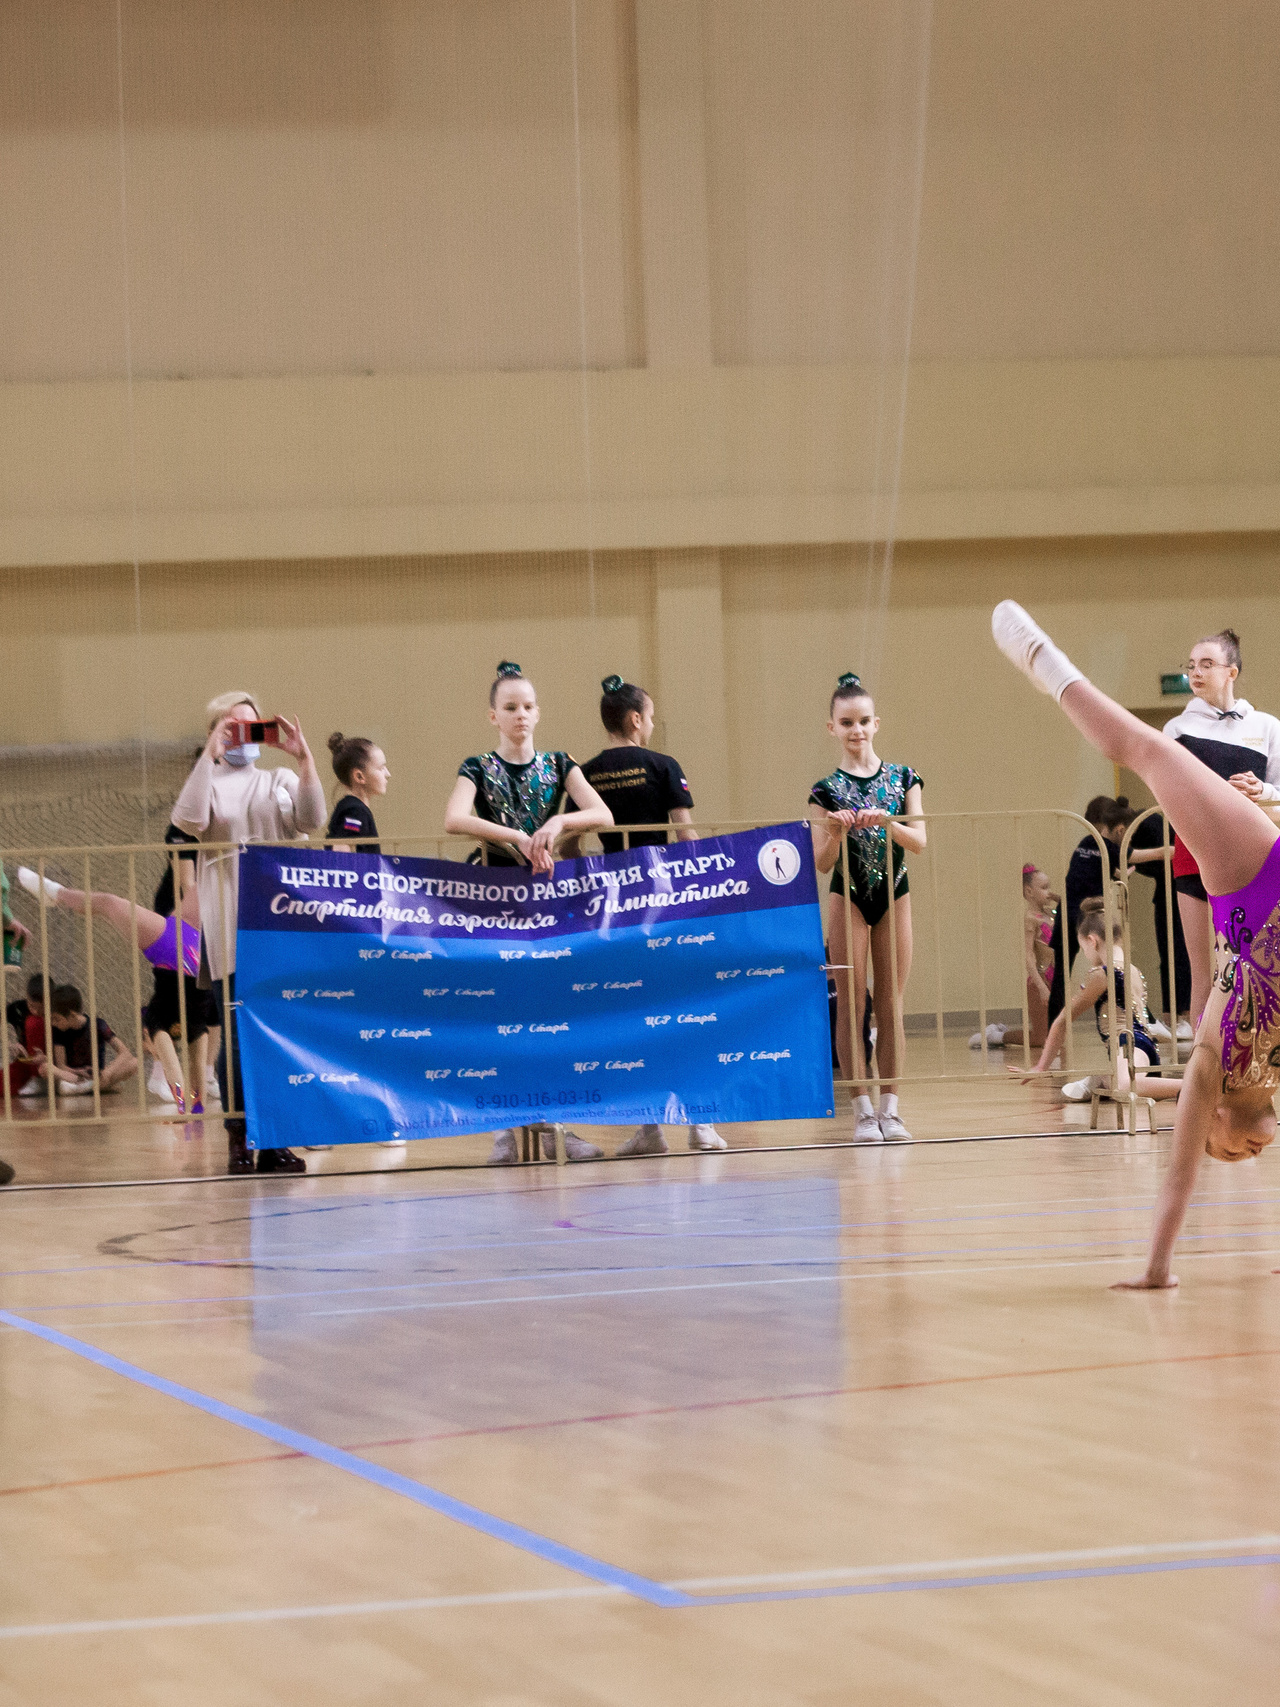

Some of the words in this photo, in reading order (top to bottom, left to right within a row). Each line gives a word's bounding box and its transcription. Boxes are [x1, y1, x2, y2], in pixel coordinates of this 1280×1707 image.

[280, 865, 359, 889] ЦЕНТР
[362, 871, 529, 902] СПОРТИВНОГО
[532, 865, 645, 901] РАЗВИТИЯ
[646, 853, 736, 881] «СТАРТ»
[269, 892, 434, 924] Спортивная
[437, 910, 559, 934] аэробика
[584, 877, 750, 917] Гимнастика
[475, 1089, 602, 1110] 8-910-116-03-16
